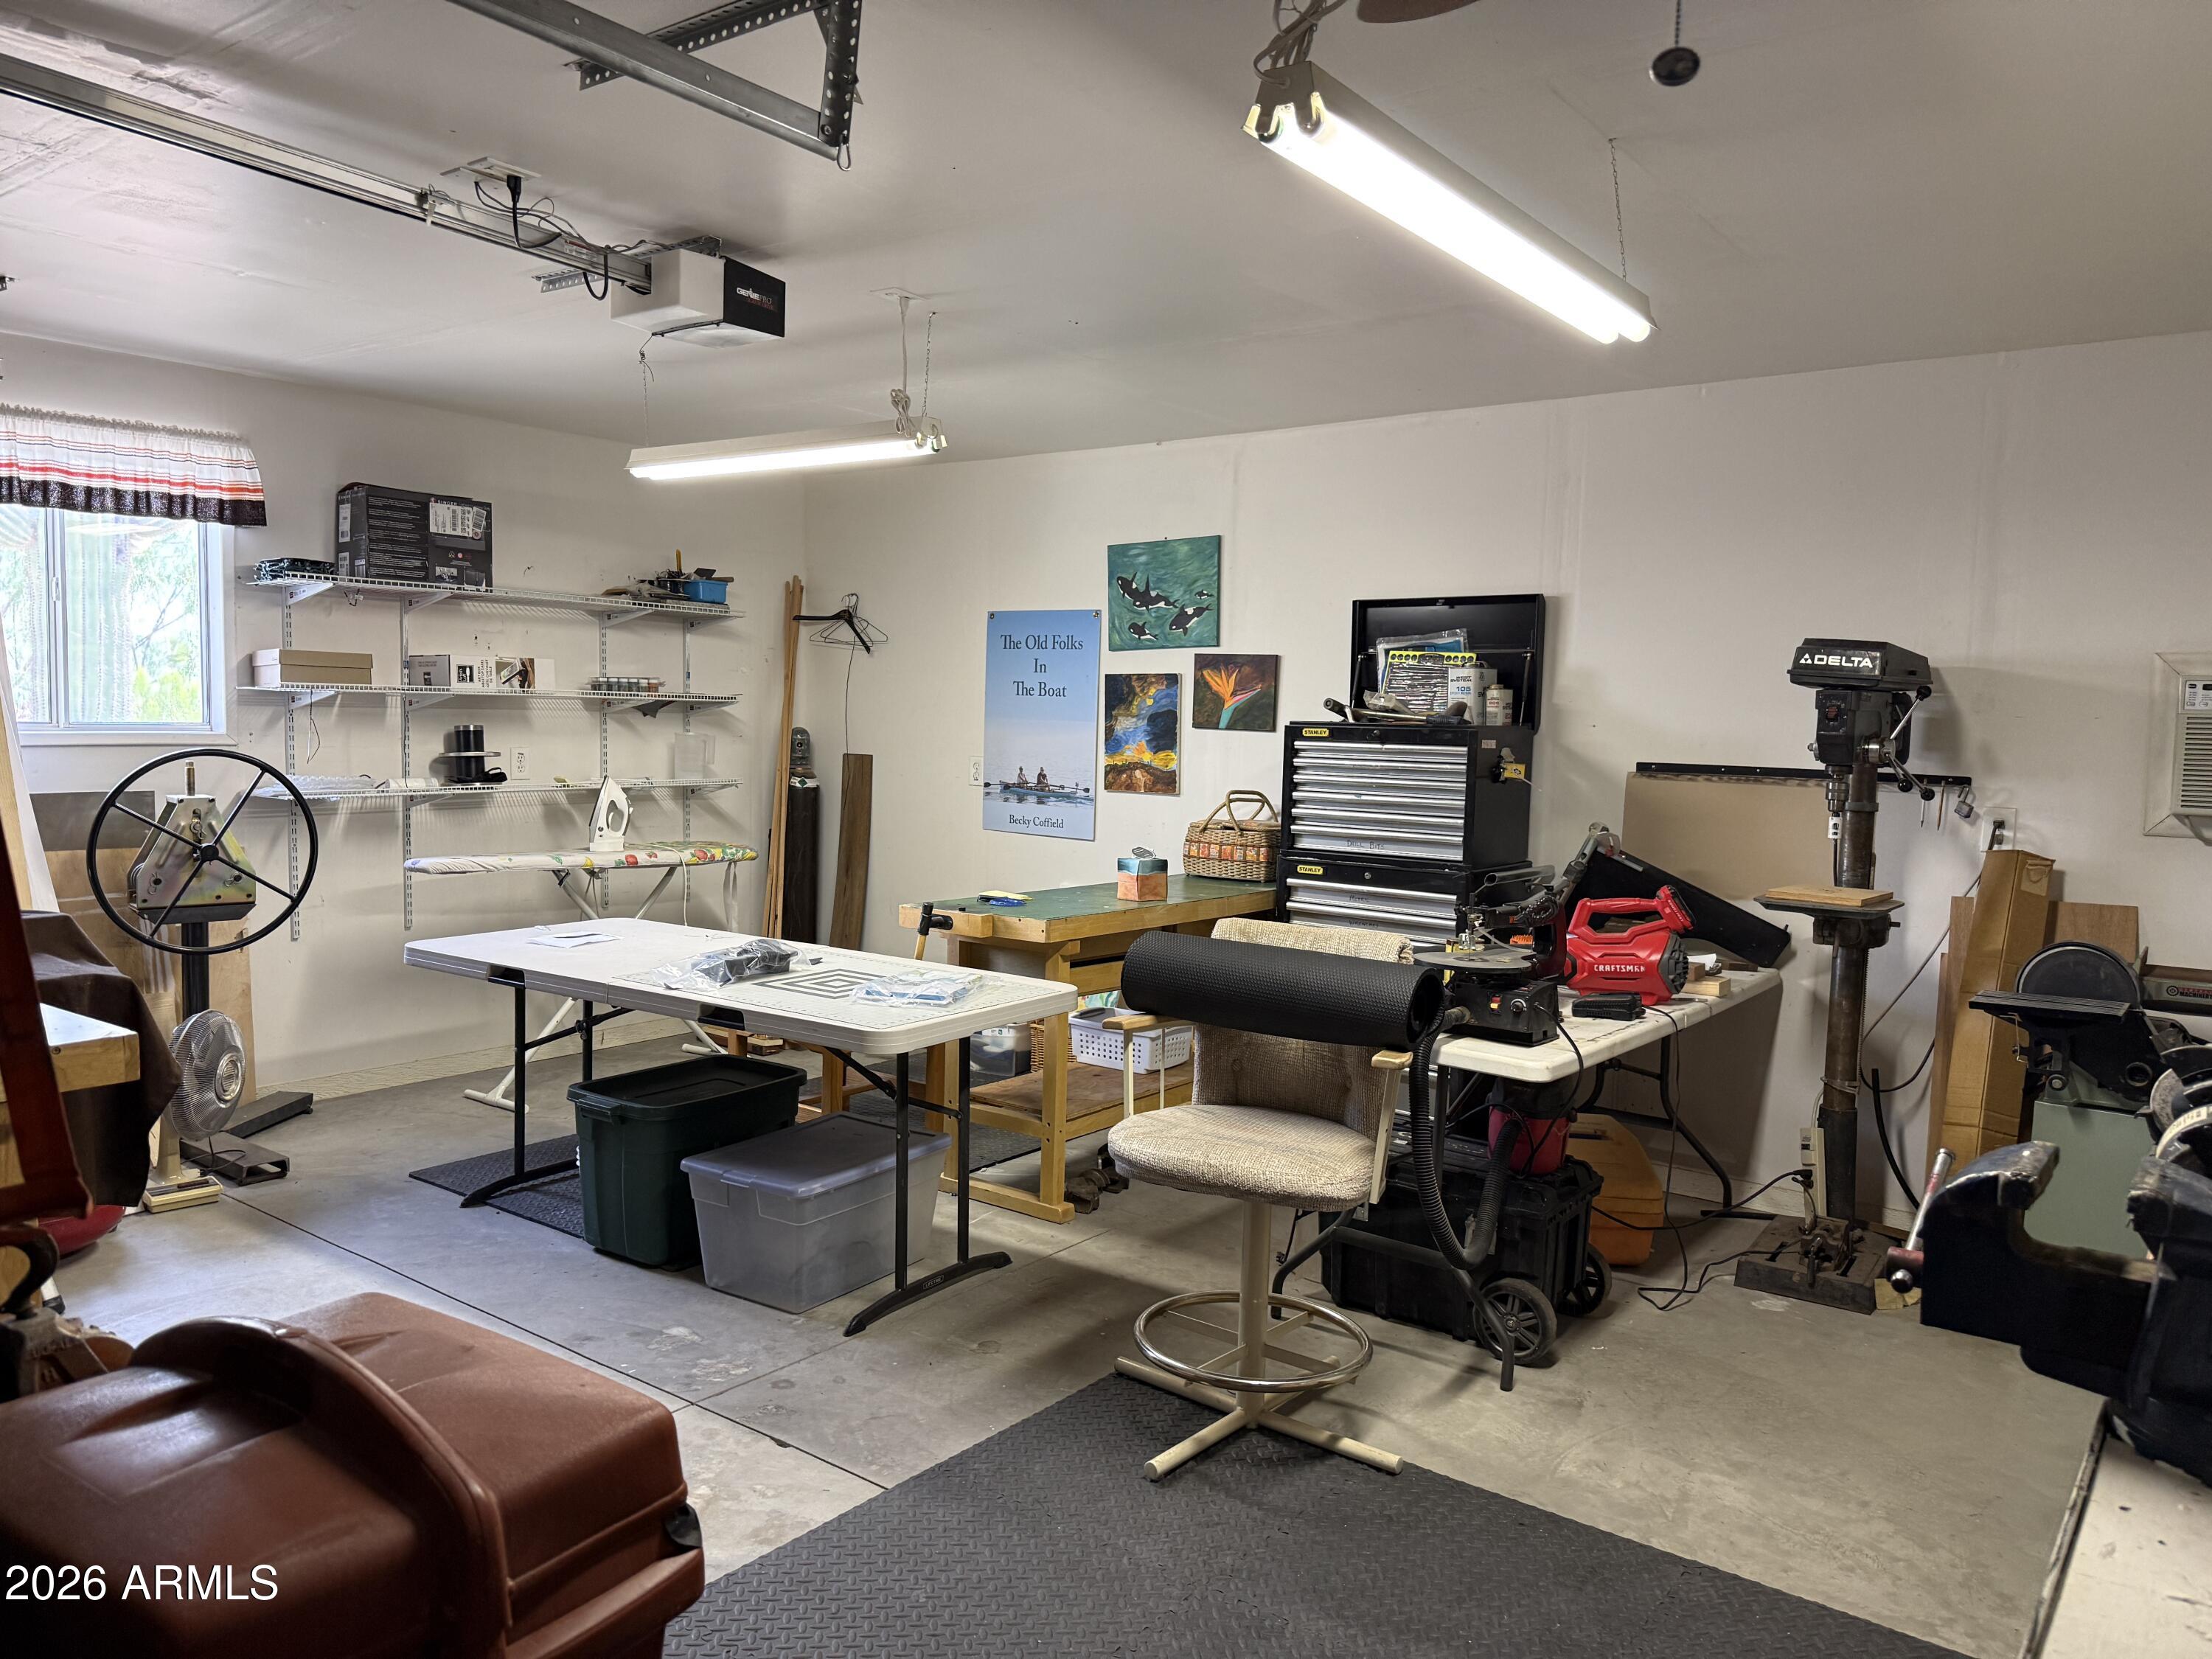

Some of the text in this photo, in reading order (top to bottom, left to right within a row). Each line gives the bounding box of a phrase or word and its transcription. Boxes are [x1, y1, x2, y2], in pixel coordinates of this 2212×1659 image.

[1000, 634, 1083, 650] The Old Folks
[1033, 658, 1047, 673] In
[1813, 654, 1874, 669] DELTA
[1012, 681, 1068, 698] The Boat
[1009, 814, 1064, 829] Becky Coffield
[1593, 964, 1646, 973] CRAFTSMAN
